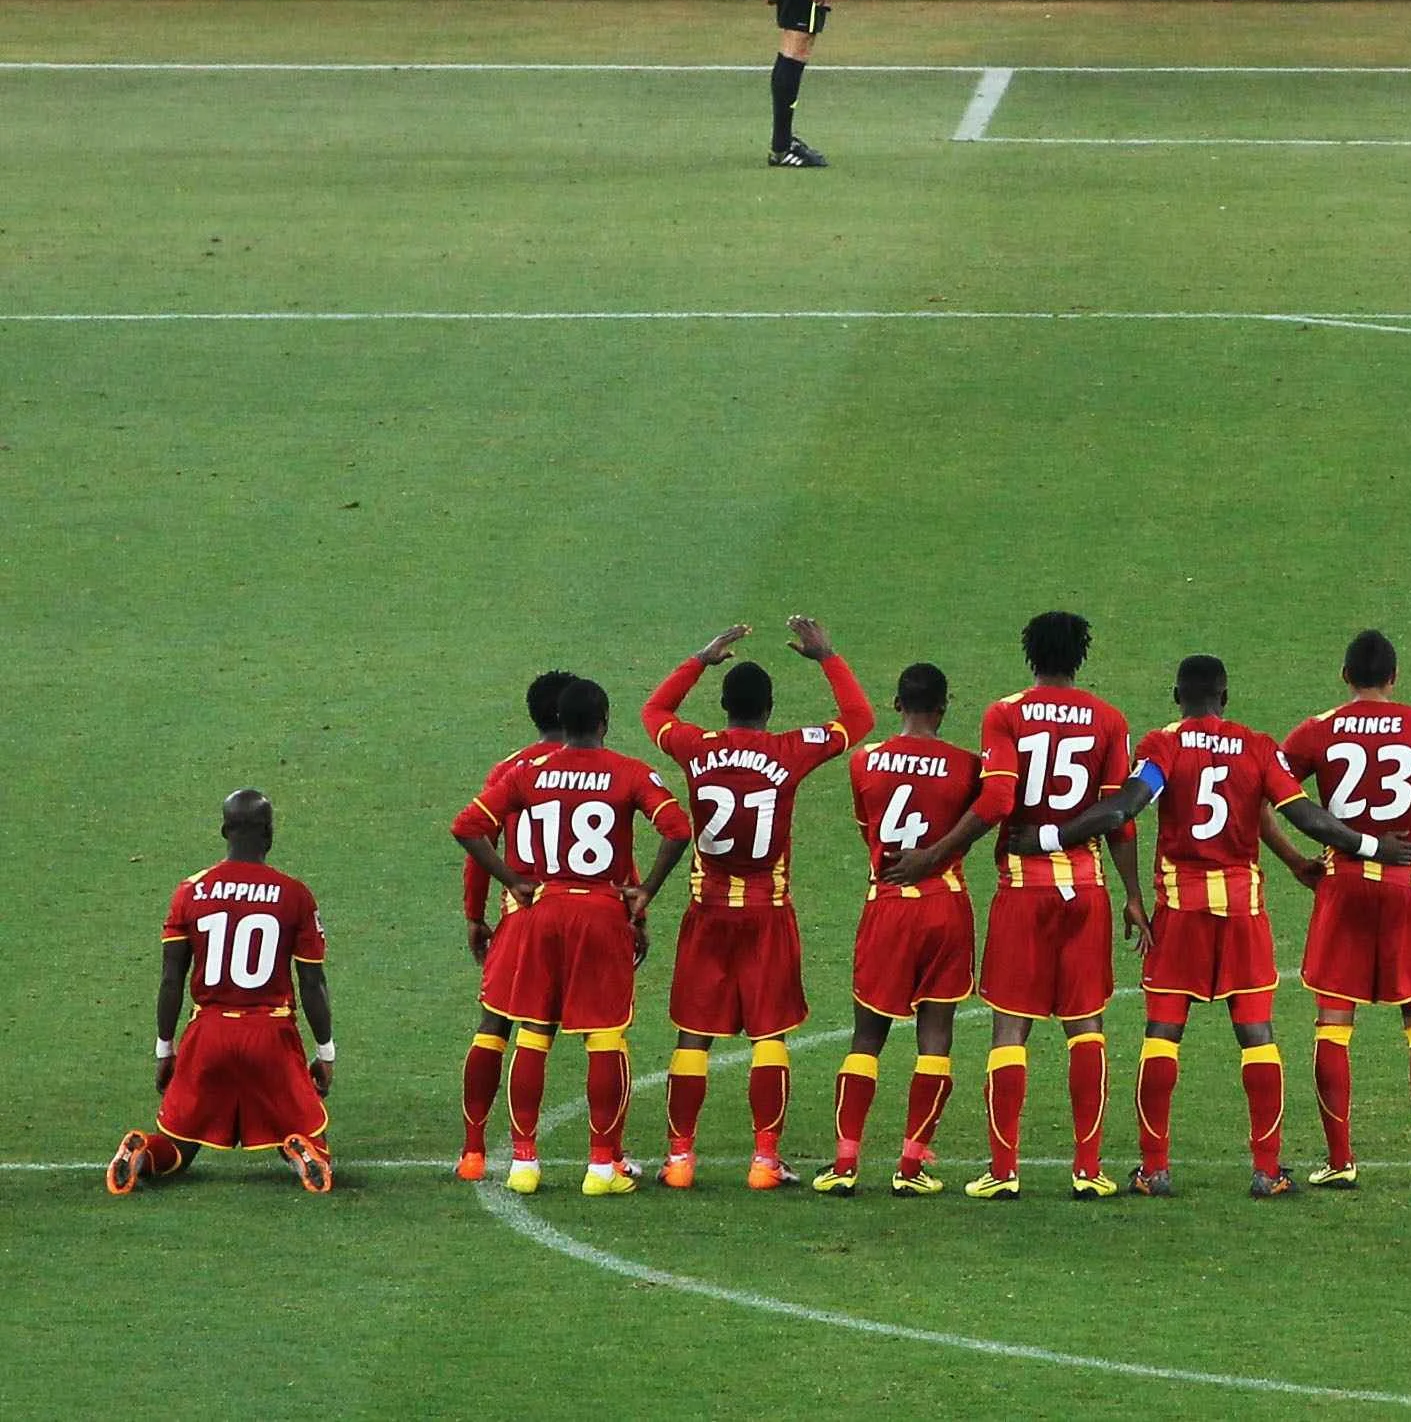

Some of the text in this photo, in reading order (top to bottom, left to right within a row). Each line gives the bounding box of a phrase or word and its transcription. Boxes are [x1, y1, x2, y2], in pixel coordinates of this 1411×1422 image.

[1021, 703, 1093, 725] VORSAH
[1332, 716, 1403, 734] PRINCE
[534, 770, 612, 791] ADIYIAH
[866, 751, 949, 778] PANTSIL
[1017, 731, 1096, 810] 15
[697, 785, 778, 859] 21
[879, 784, 929, 850] 4
[1191, 765, 1229, 840] 5
[530, 800, 616, 876] 18
[192, 880, 281, 903] S. APPIAH
[196, 911, 280, 989] 10
